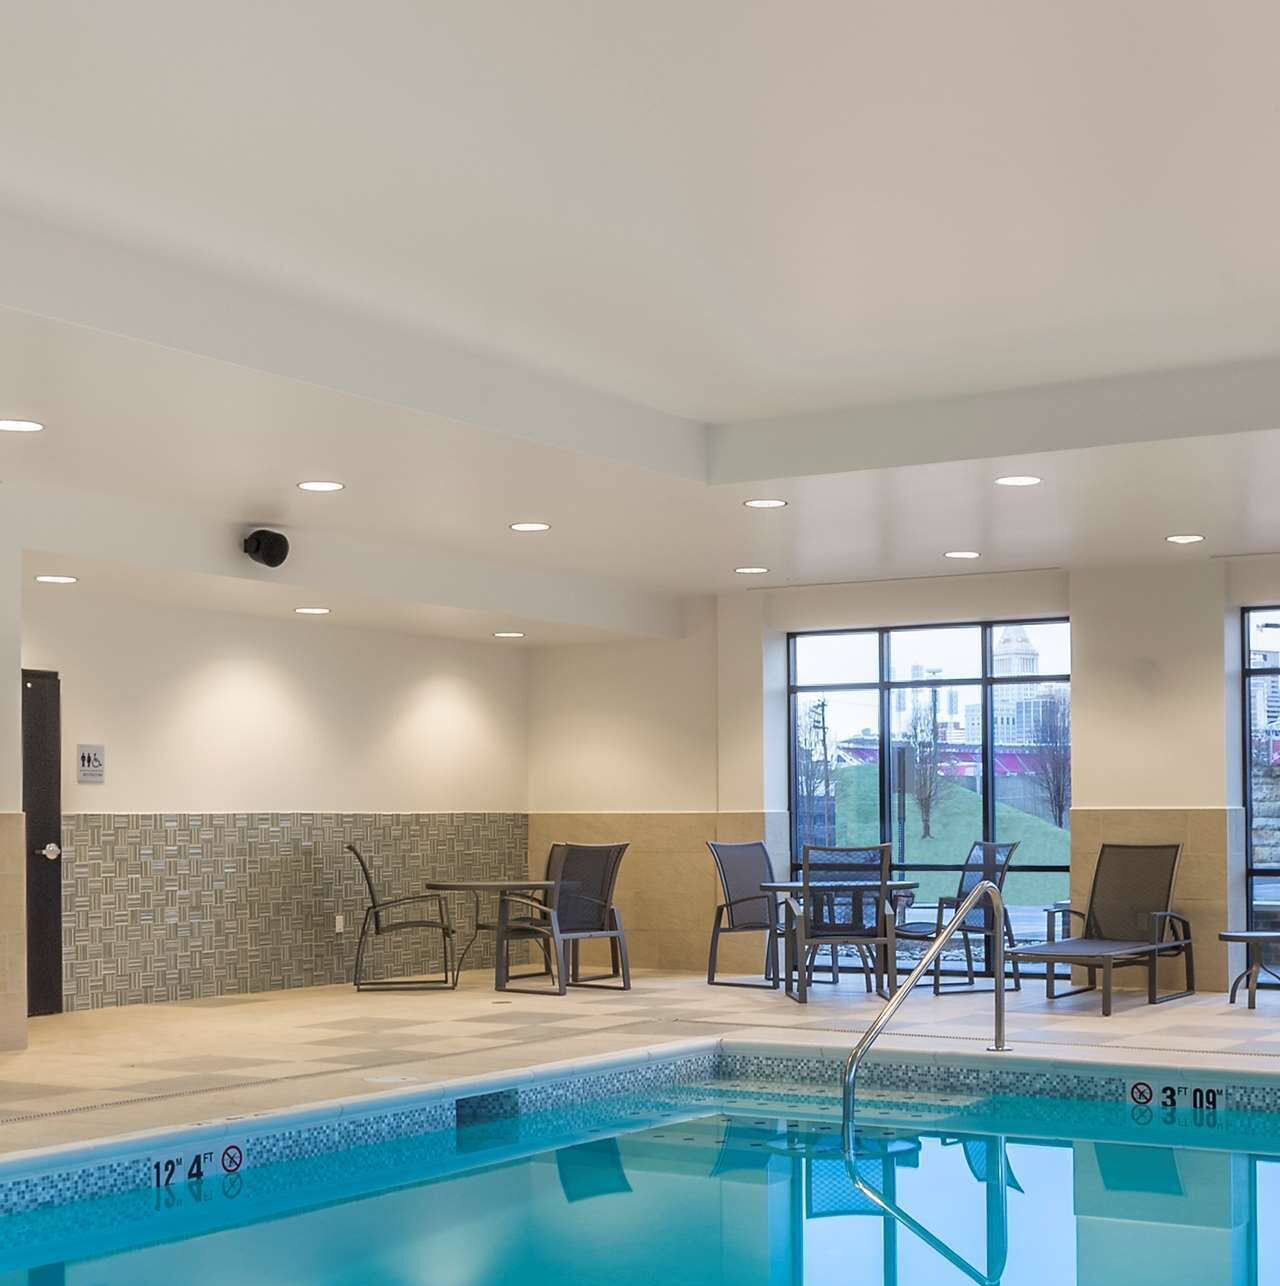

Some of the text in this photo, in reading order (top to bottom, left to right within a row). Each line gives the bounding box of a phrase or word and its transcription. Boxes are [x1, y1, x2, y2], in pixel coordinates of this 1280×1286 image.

[1161, 1086, 1177, 1108] 3
[1177, 1087, 1188, 1096] FT
[187, 1154, 204, 1180] 4
[202, 1151, 214, 1164] FT
